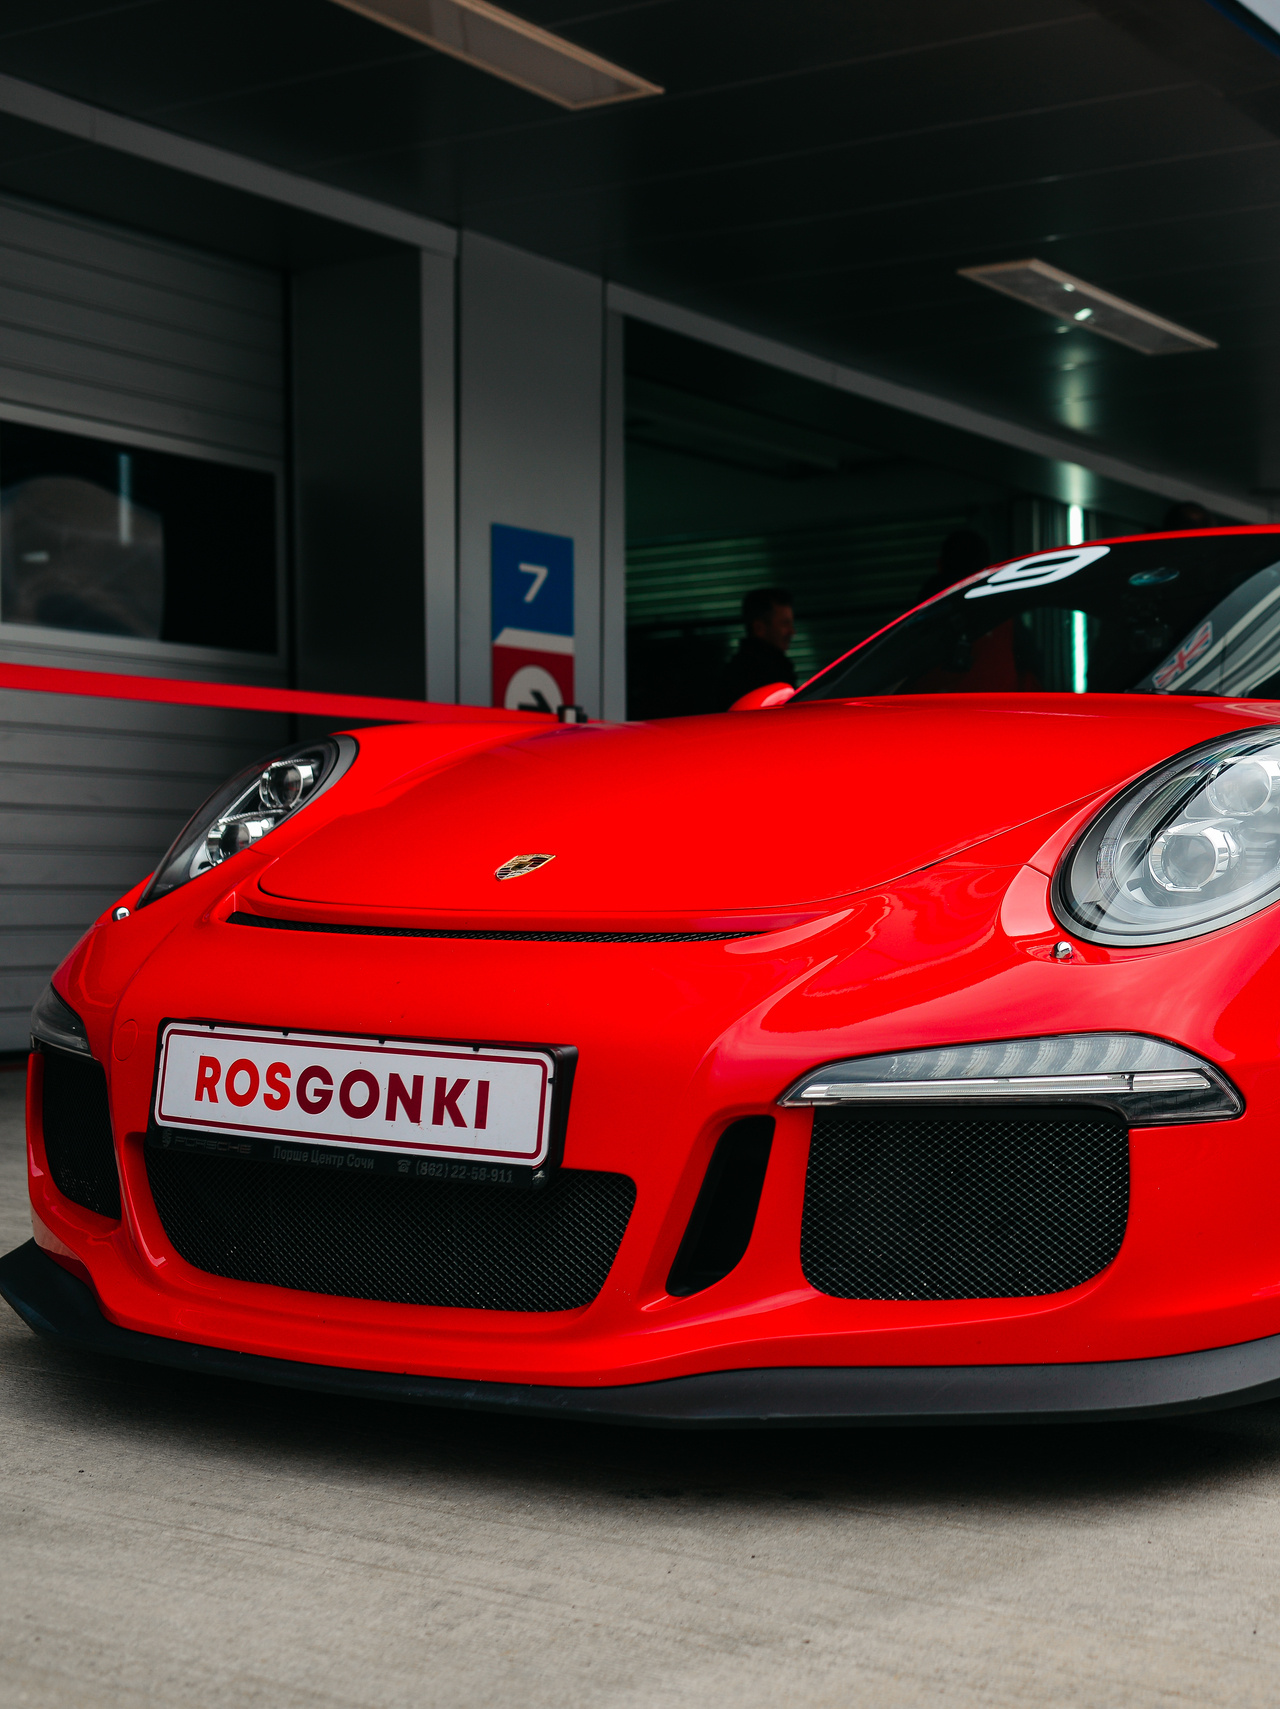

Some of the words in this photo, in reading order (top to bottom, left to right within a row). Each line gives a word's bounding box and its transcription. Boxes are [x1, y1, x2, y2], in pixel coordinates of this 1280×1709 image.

[519, 563, 548, 602] 7
[194, 1055, 490, 1130] ROSGONKI
[174, 1136, 252, 1154] PORSCHE
[272, 1145, 308, 1163] Порше
[311, 1149, 344, 1168] Центр
[346, 1153, 375, 1170] Сочи
[450, 1165, 514, 1184] 22-58-911
